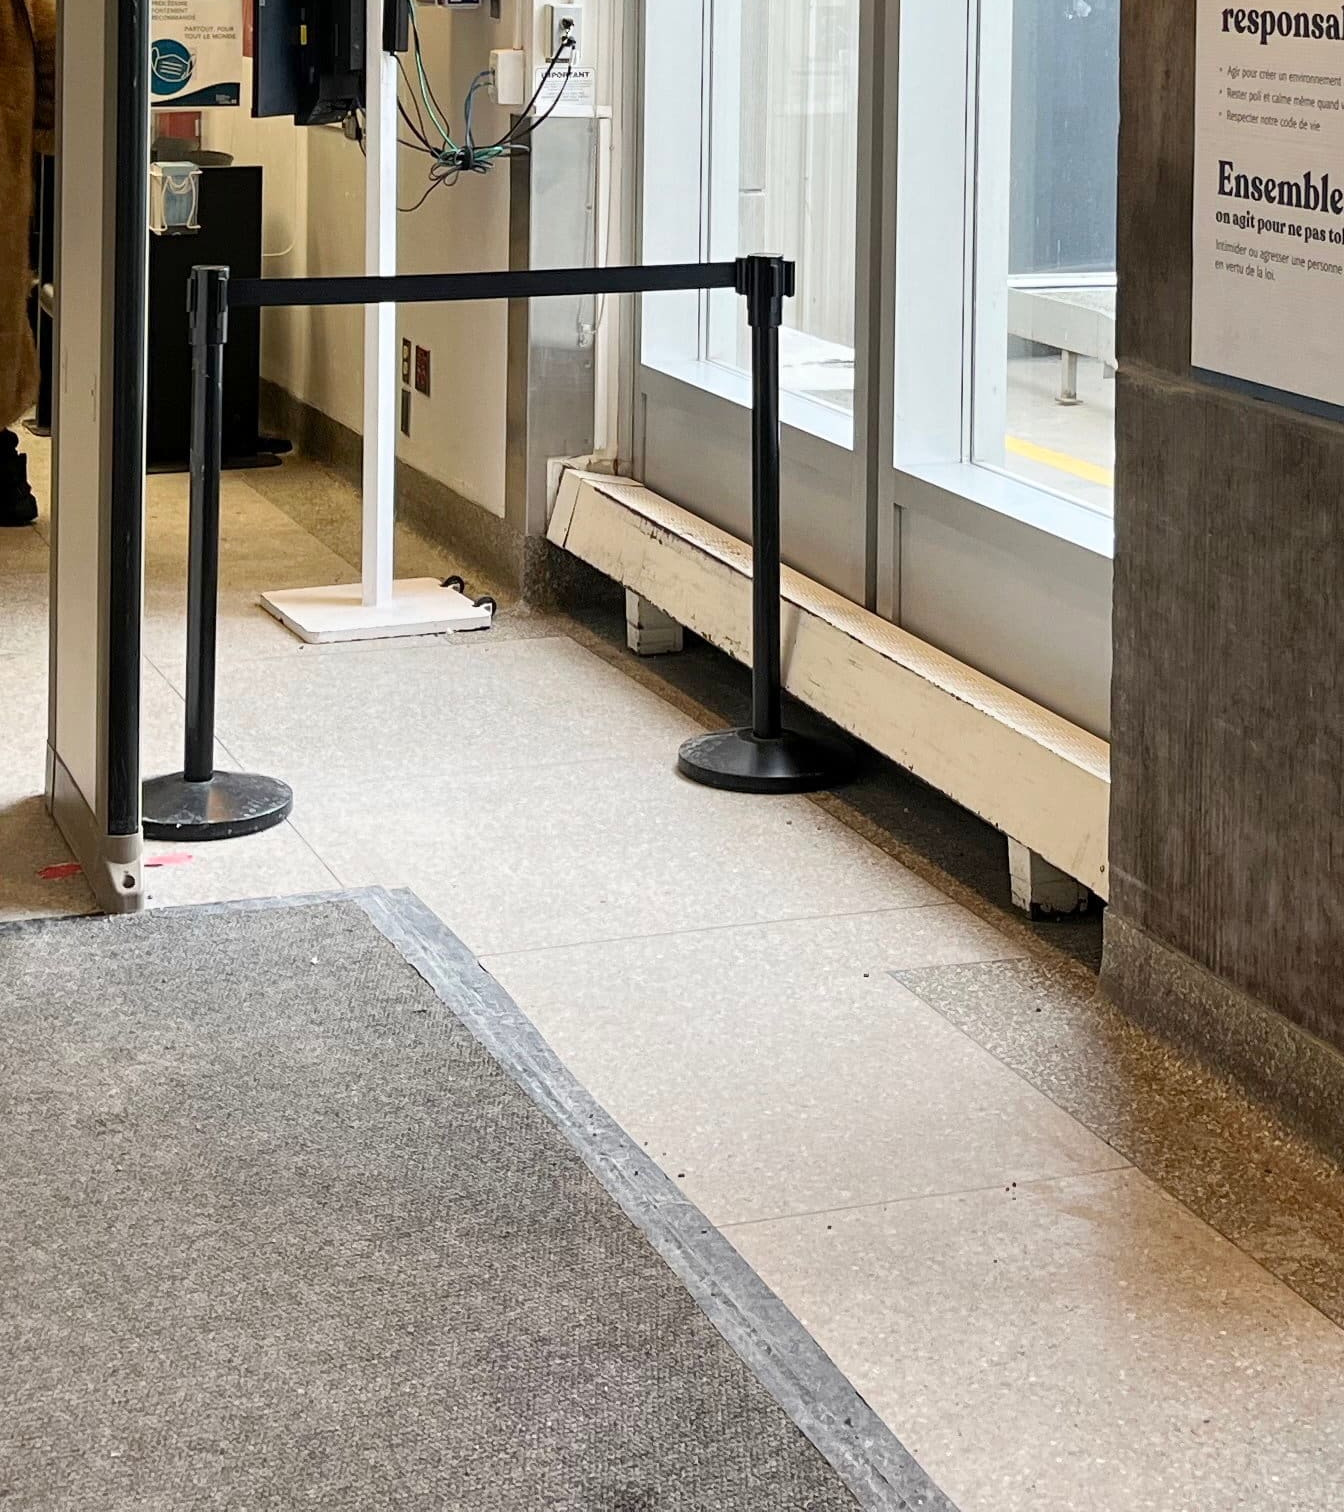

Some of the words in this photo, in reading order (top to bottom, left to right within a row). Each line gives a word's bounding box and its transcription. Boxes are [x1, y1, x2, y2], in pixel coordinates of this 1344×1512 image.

[1226, 65, 1240, 80] Agir
[1242, 67, 1257, 79] pour
[1259, 69, 1277, 81] créer
[1278, 72, 1287, 81] un
[1288, 72, 1342, 87] environnement
[1248, 90, 1262, 102] poli
[1263, 92, 1271, 103] et
[1271, 93, 1292, 105] calme
[1293, 95, 1315, 107] même
[1317, 98, 1339, 110] quand
[1226, 109, 1259, 124] Respecter
[1260, 115, 1279, 126] notre
[1279, 116, 1297, 129] code
[1298, 117, 1308, 130] de
[1309, 121, 1321, 131] vie
[1215, 211, 1231, 224] on
[1232, 210, 1255, 230] agit
[1257, 217, 1286, 235] pour
[1288, 223, 1302, 237] ne
[1304, 226, 1326, 243] pas
[1215, 238, 1247, 255] Intimider
[1248, 247, 1259, 258] ou
[1259, 249, 1290, 264] agresser
[1291, 256, 1306, 268] une
[1307, 257, 1343, 276] personne
[1214, 259, 1224, 270] en
[1225, 263, 1244, 275] vertu
[1245, 264, 1255, 277] de
[1256, 266, 1263, 279] la
